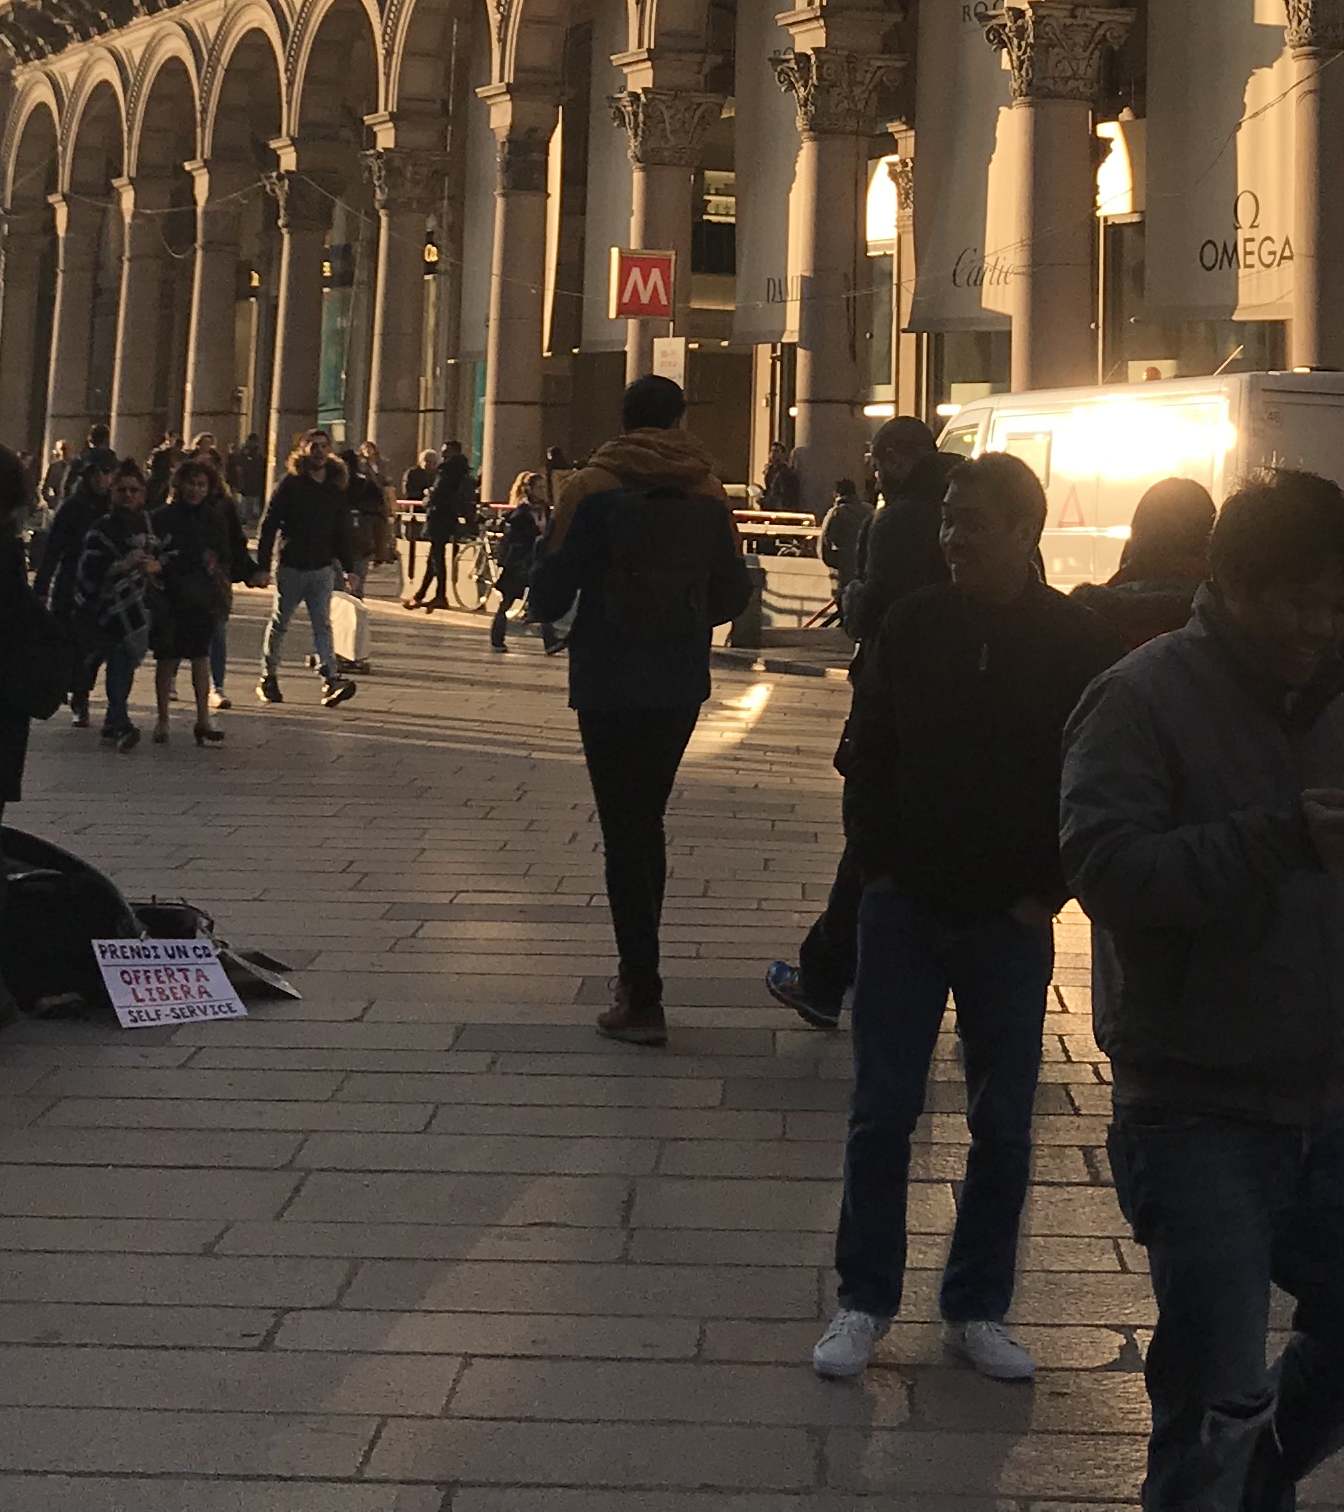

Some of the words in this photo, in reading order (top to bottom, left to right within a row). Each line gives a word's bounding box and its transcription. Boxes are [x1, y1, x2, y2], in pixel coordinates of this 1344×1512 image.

[1199, 234, 1294, 272] OMEGA
[952, 248, 1016, 288] Cartie
[622, 267, 668, 305] M
[98, 944, 161, 960] PRENDI
[163, 945, 189, 959] UN
[193, 945, 213, 958] CD
[119, 965, 210, 986] OFFERTA
[130, 984, 213, 1003] LIBERA
[128, 1002, 238, 1024] SELF-SERVICE
